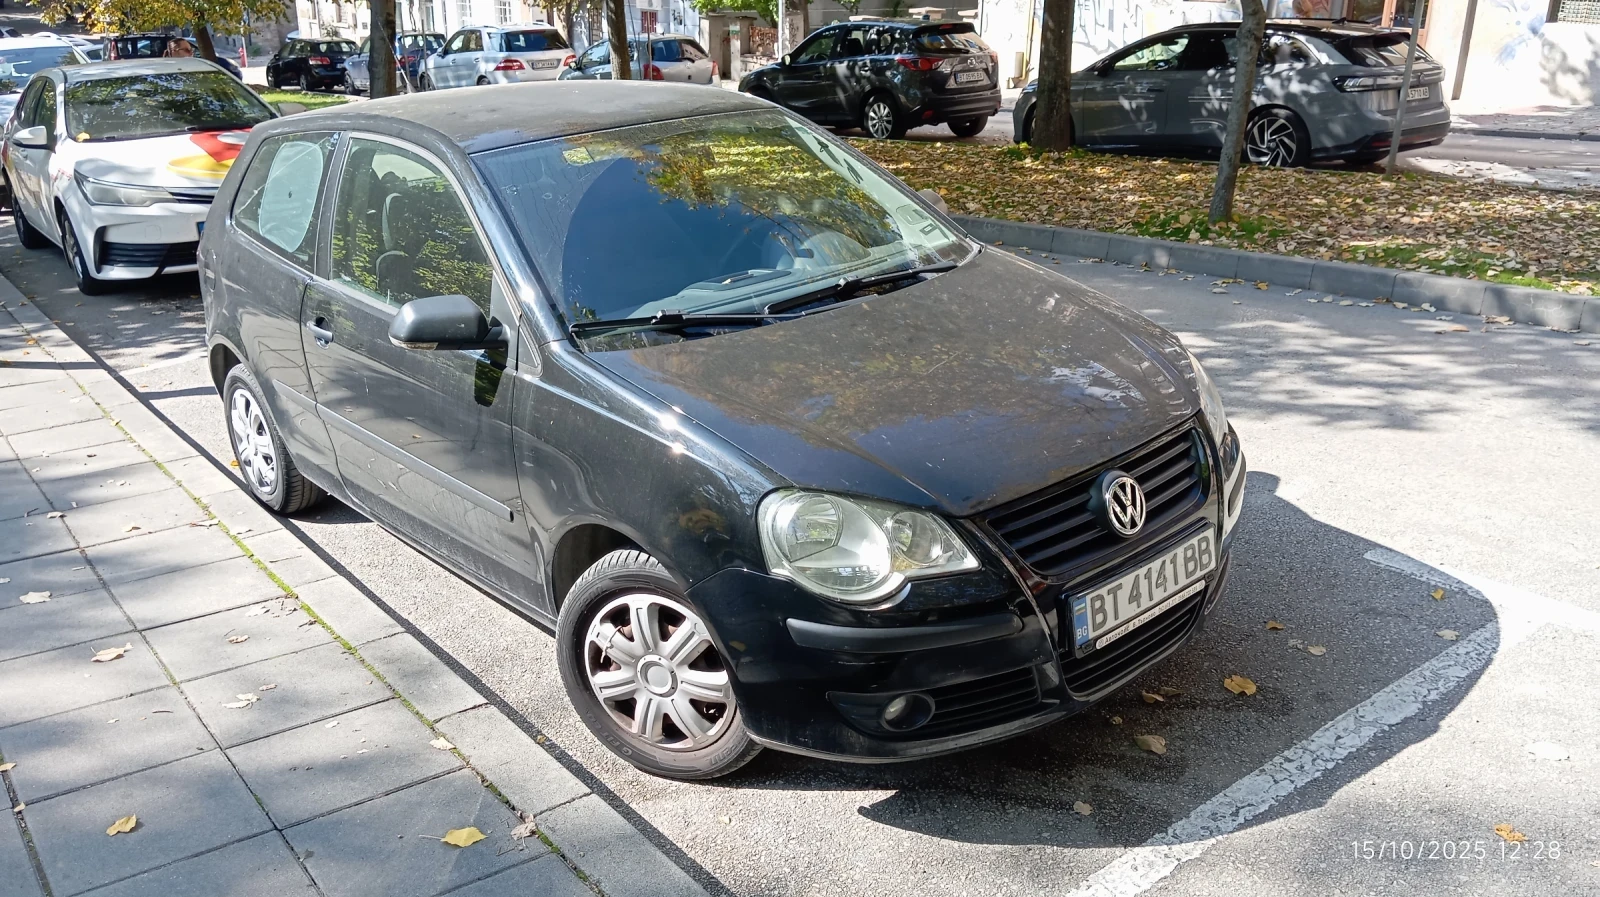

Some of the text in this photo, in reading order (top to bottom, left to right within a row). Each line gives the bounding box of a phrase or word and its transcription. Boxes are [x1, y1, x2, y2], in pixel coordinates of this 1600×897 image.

[1090, 583, 1123, 632] BT
[1128, 552, 1179, 608] 4141
[1183, 535, 1212, 580] BB
[1076, 625, 1088, 639] BG
